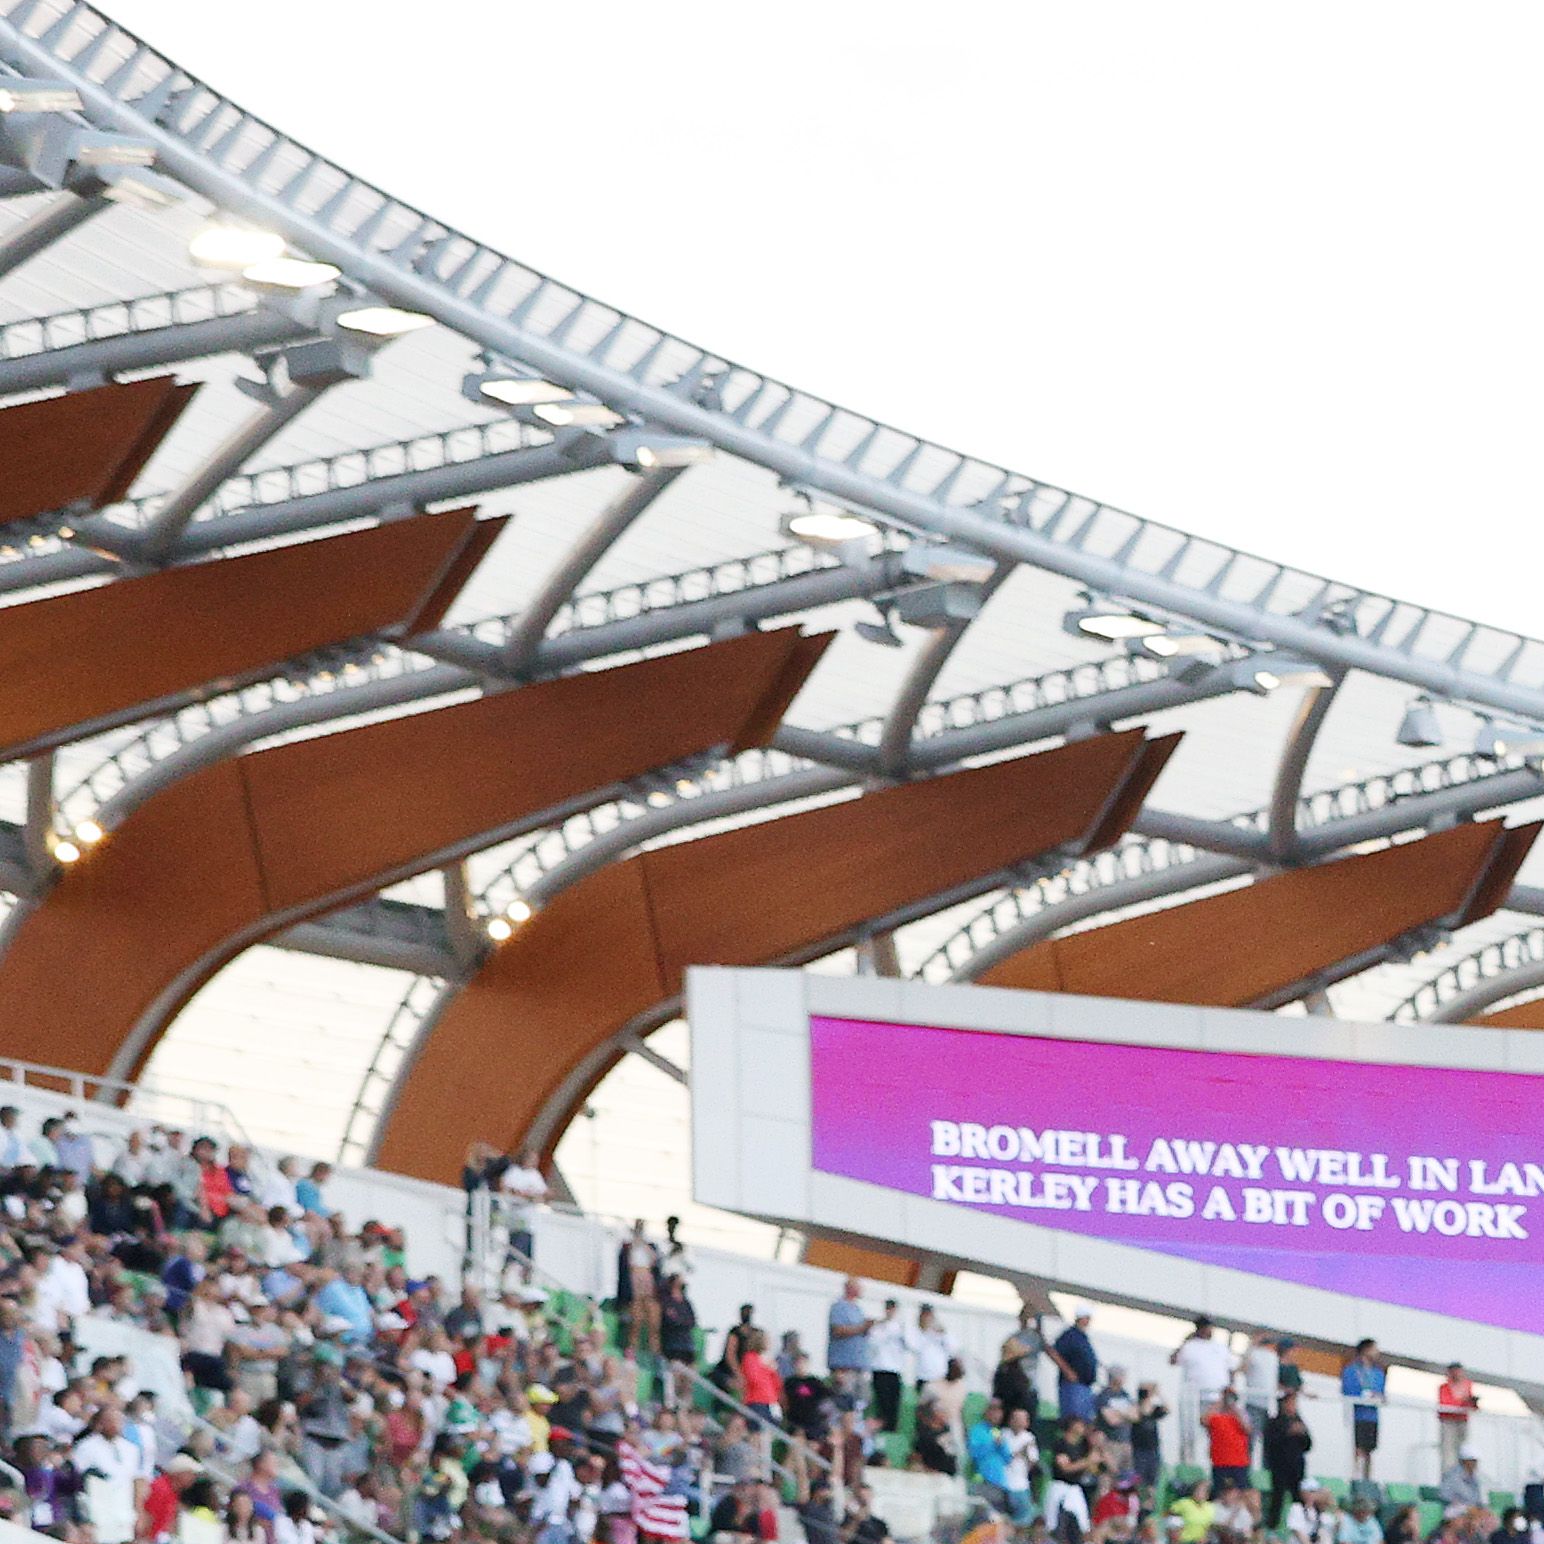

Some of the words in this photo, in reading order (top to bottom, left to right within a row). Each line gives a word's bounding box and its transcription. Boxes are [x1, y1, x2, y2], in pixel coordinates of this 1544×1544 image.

[931, 1120, 1139, 1170] BROMELL
[1144, 1138, 1271, 1179] AWAY
[1274, 1147, 1400, 1187] WELL
[1407, 1156, 1459, 1192] IN
[931, 1165, 1099, 1211] KERLEY
[1104, 1177, 1195, 1218] HAS
[1201, 1186, 1236, 1221] A
[1242, 1188, 1316, 1226] BIT
[1321, 1193, 1386, 1231] OF
[1391, 1197, 1529, 1240] WORK
